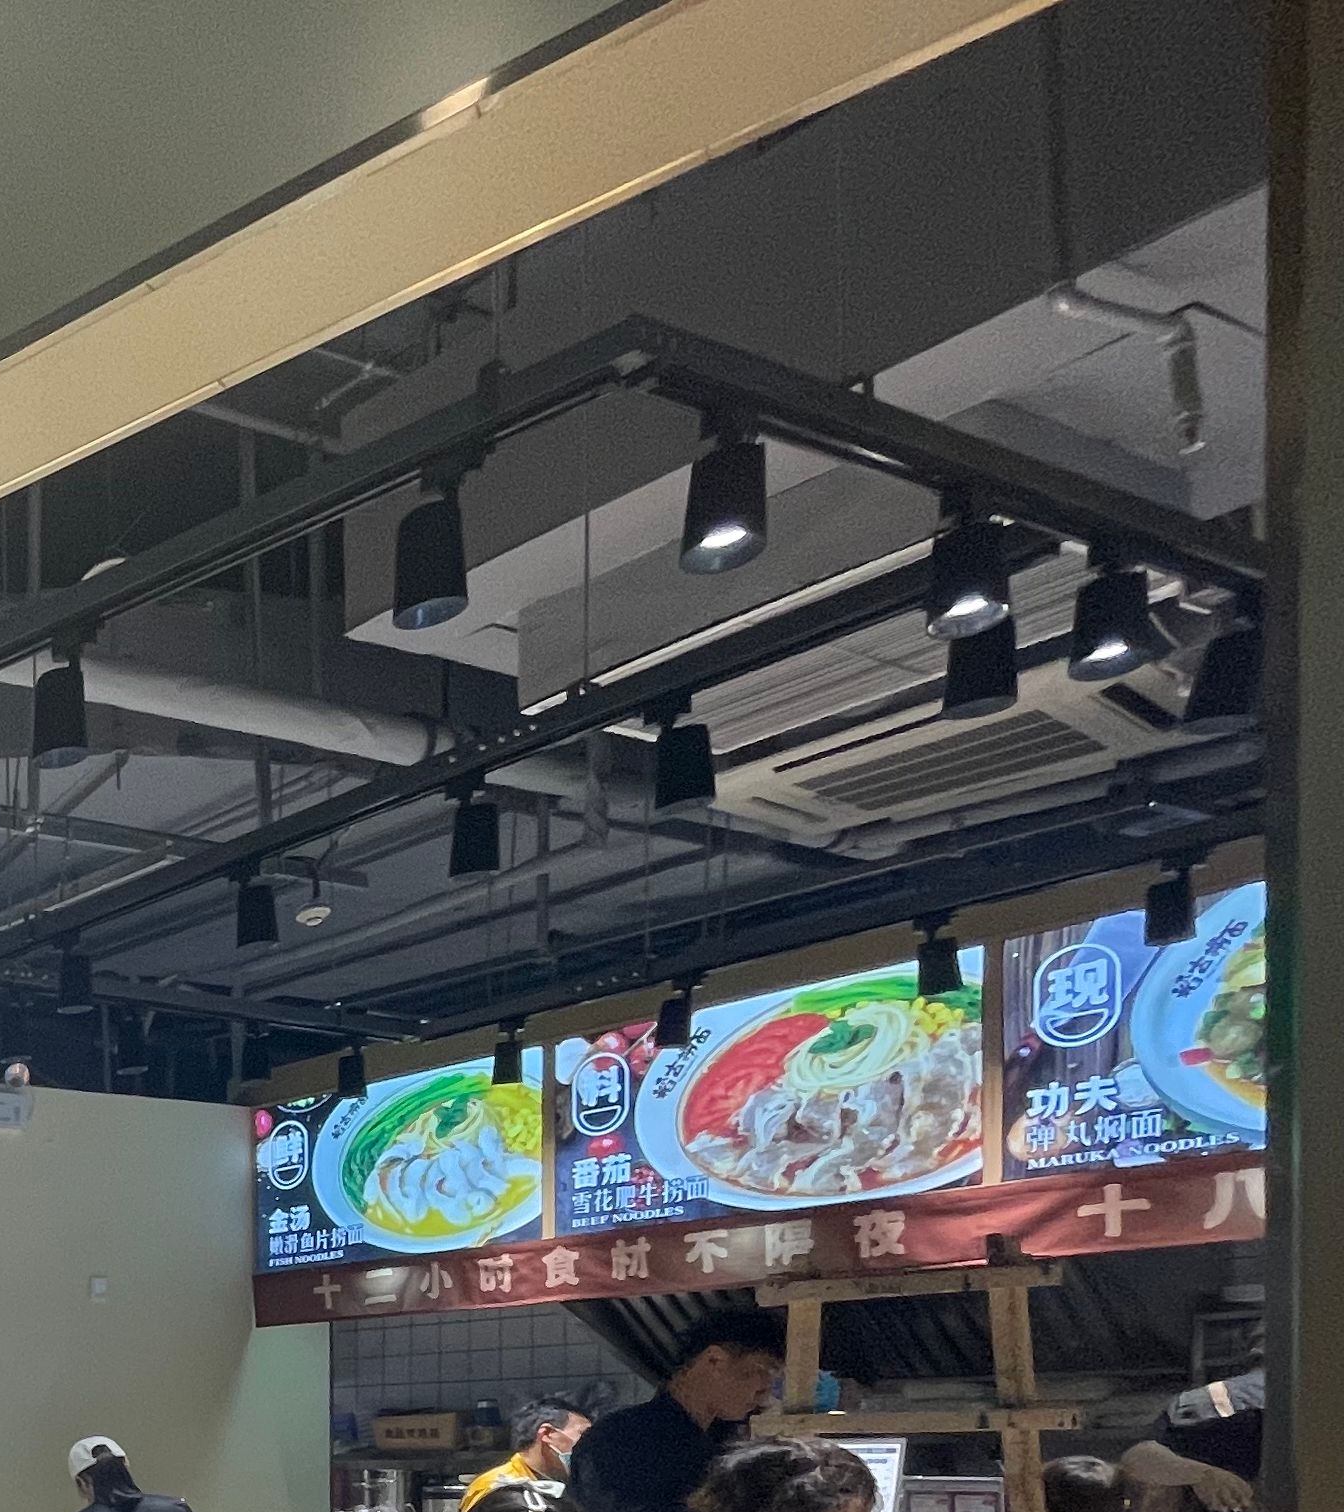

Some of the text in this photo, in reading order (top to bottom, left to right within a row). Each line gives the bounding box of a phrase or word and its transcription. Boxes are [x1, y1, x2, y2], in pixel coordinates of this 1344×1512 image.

[1047, 959, 1109, 1009] 现
[578, 1067, 622, 1106] 料
[1026, 1075, 1118, 1118] 功夫
[1026, 1108, 1163, 1152] 弹丸焖面
[1027, 1131, 1240, 1170] MARUKA NOODLES
[572, 1152, 632, 1189] 番茄
[571, 1174, 710, 1214] 雪花肥牛捞面
[269, 1204, 311, 1234] 金汤
[572, 1205, 685, 1228] BEEF NOODLES
[269, 1249, 344, 1267] FISH NOODLES
